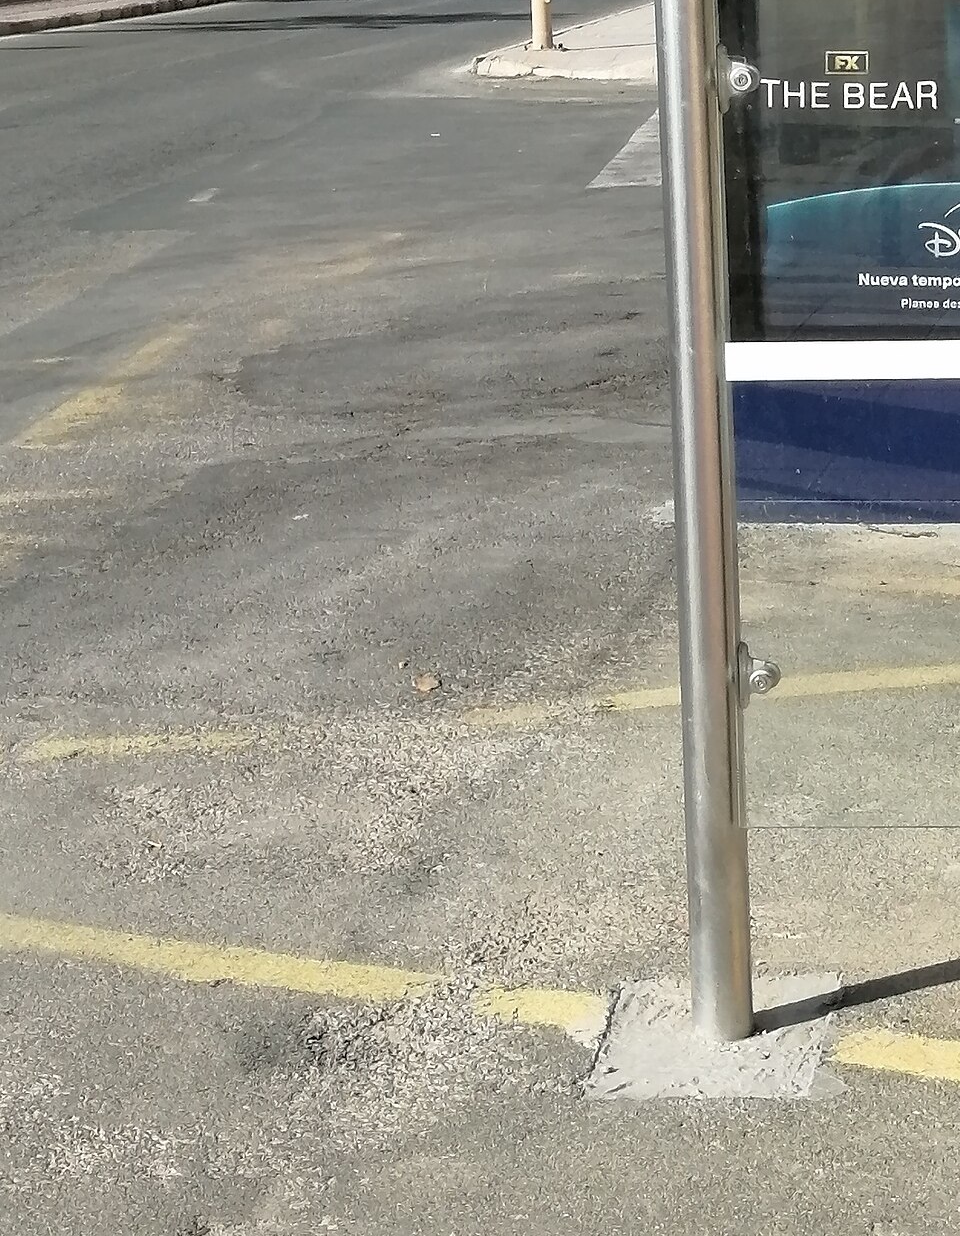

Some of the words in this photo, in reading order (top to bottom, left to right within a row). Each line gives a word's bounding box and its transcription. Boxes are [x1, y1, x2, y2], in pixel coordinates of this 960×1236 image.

[834, 55, 860, 70] FX
[760, 78, 830, 109] THE
[843, 80, 938, 110] BEAR
[858, 273, 908, 286] Nueva
[900, 298, 940, 309] Planos
